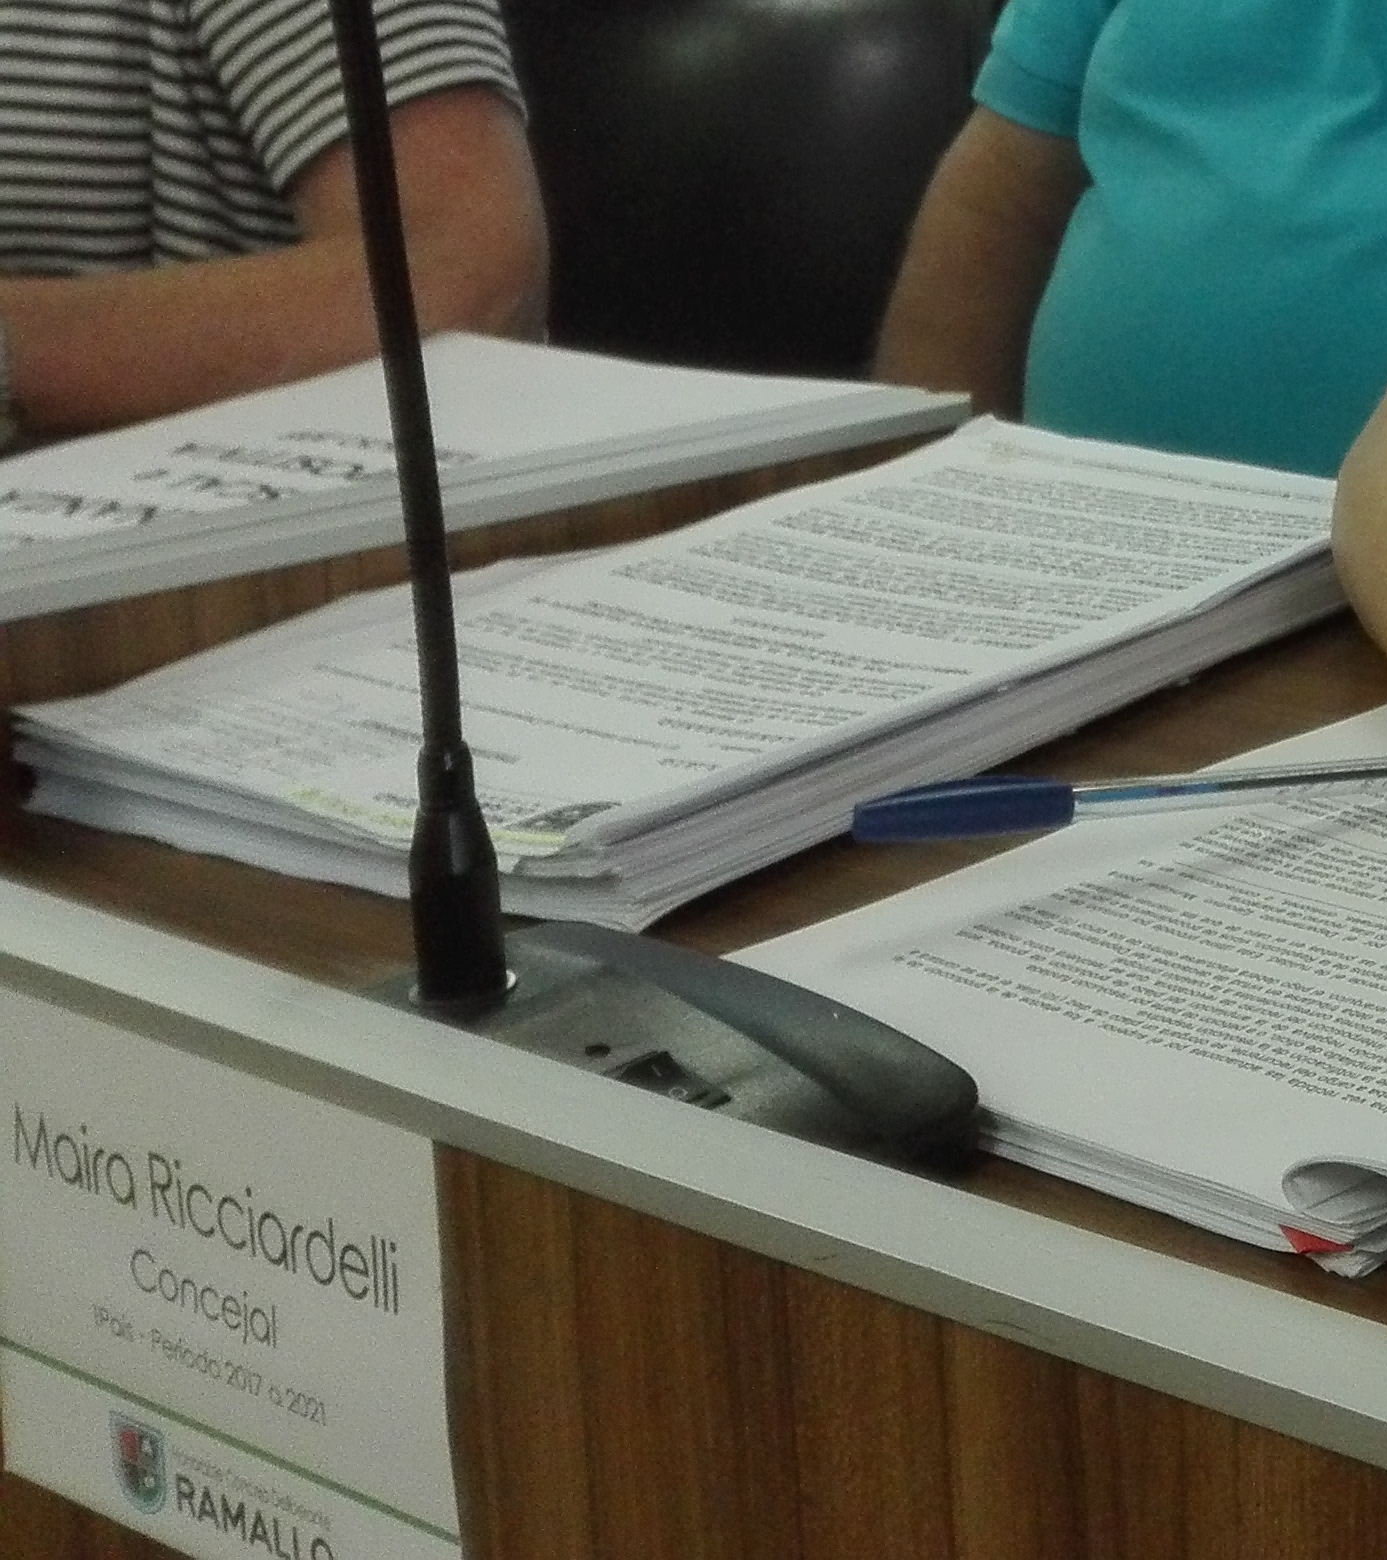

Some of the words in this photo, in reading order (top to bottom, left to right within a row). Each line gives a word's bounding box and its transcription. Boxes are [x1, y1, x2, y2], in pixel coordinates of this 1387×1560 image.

[12, 1102, 137, 1210] Maira
[147, 1149, 400, 1316] Ricciardelli
[129, 1248, 279, 1349] Concejal
